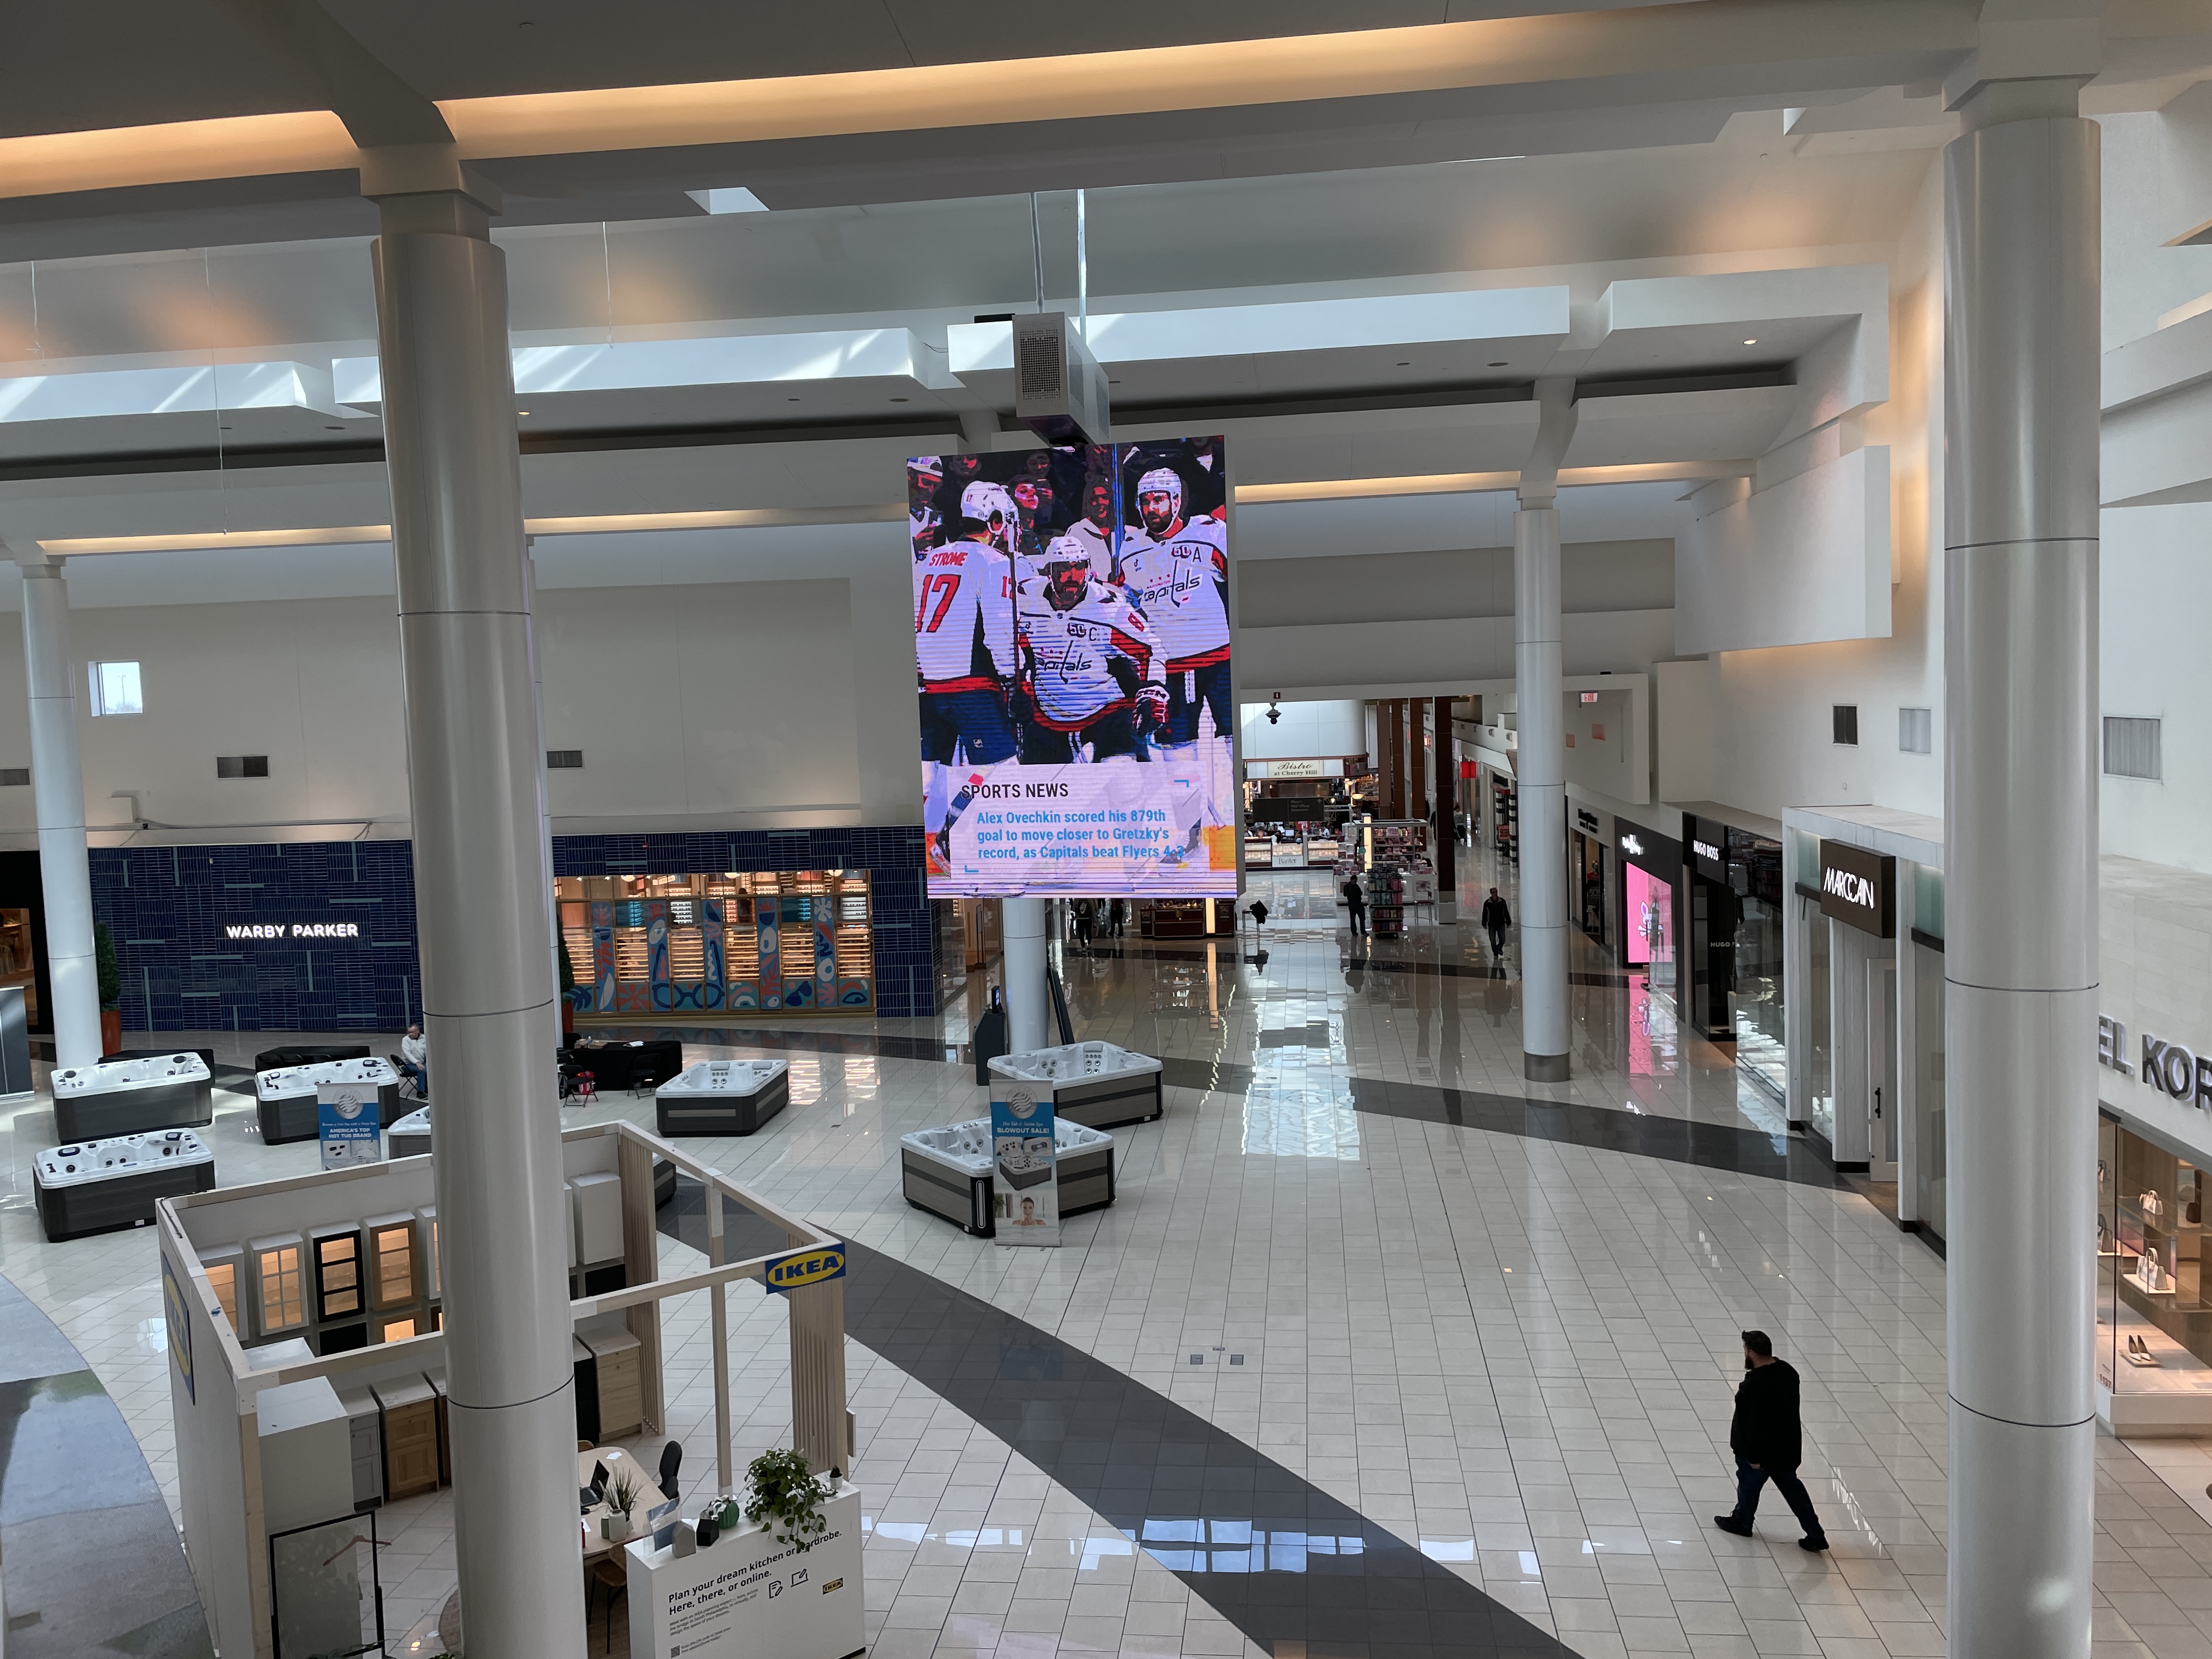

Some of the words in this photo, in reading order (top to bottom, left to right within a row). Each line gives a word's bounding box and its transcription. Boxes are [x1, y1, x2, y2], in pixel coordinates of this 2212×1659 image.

[929, 552, 968, 567] STROME
[1192, 546, 1201, 563] A
[916, 574, 961, 633] 17
[1088, 627, 1097, 641] C
[1277, 761, 1313, 770] Bistro
[961, 783, 1020, 799] SPORTS
[1026, 783, 1069, 798] NEWS
[977, 811, 1002, 824] Alex
[1006, 810, 1060, 823] Ovechkin
[1064, 809, 1105, 823] scored
[1109, 809, 1127, 822] his
[1130, 809, 1165, 822] 879th
[977, 829, 1002, 844] goal
[1006, 830, 1017, 841] to
[1022, 831, 1053, 841] move
[1057, 827, 1093, 840] closer
[1097, 828, 1109, 840] to
[1113, 827, 1169, 843] Gretzky's
[978, 846, 1019, 861] record,
[1023, 848, 1036, 858] as
[1040, 845, 1088, 861] Capitals
[1092, 845, 1119, 857] beat
[1122, 845, 1159, 860] Flyers
[1163, 845, 1184, 858] 4-3
[1694, 839, 1706, 857] HUGO
[1706, 845, 1719, 861] BOSS
[226, 925, 285, 939] WARBY
[292, 923, 358, 938] PARKER
[775, 1255, 840, 1282] IKEA
[668, 1589, 690, 1603] Plan
[692, 1580, 714, 1596] your
[716, 1567, 747, 1584] dream
[749, 1553, 783, 1572] kitchen
[786, 1548, 795, 1557] or
[804, 1530, 842, 1549] ardrobe.
[669, 1601, 695, 1616] Here,
[697, 1588, 726, 1604] there,
[729, 1582, 738, 1592] or
[741, 1570, 772, 1587] online.
